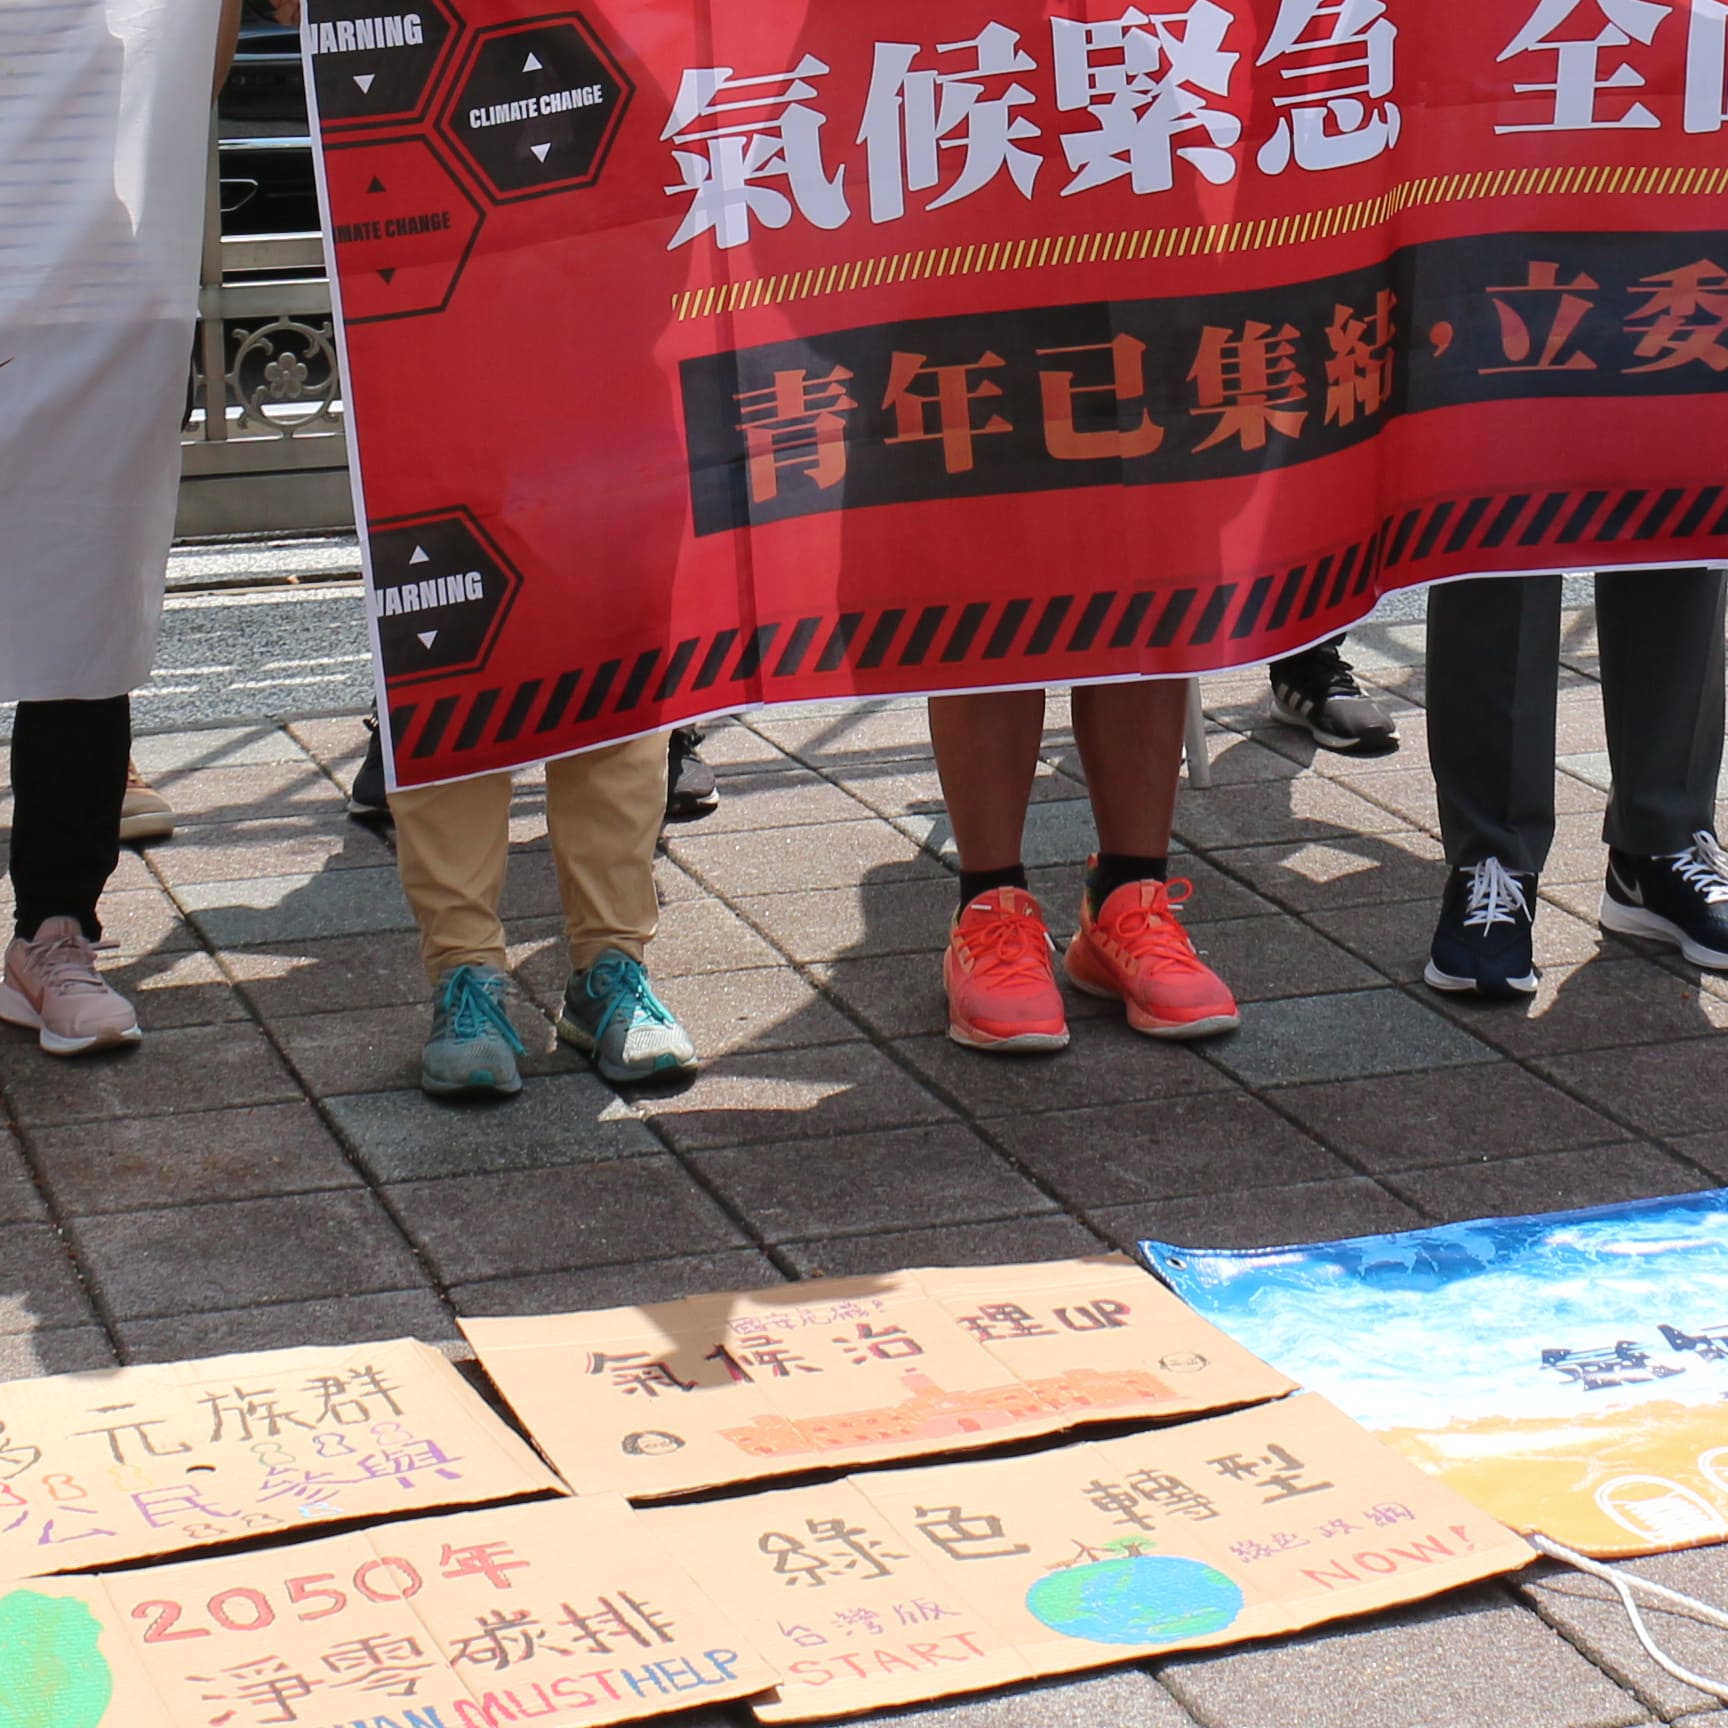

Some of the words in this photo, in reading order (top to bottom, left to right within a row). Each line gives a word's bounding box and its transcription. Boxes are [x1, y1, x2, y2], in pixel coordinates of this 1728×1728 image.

[468, 95, 538, 129] CLIMATE
[539, 84, 604, 118] CHANGE
[384, 210, 452, 240] CHANGE
[756, 1440, 1338, 1593] 綠色轉型
[130, 1539, 532, 1644] 2050年
[1299, 1522, 1480, 1593] NOW!
[185, 1588, 679, 1728] 淨零碳排
[775, 1593, 964, 1654] 台灣版
[786, 1627, 990, 1690] START
[452, 1668, 623, 1728] MUST
[619, 1647, 739, 1699] HELP
